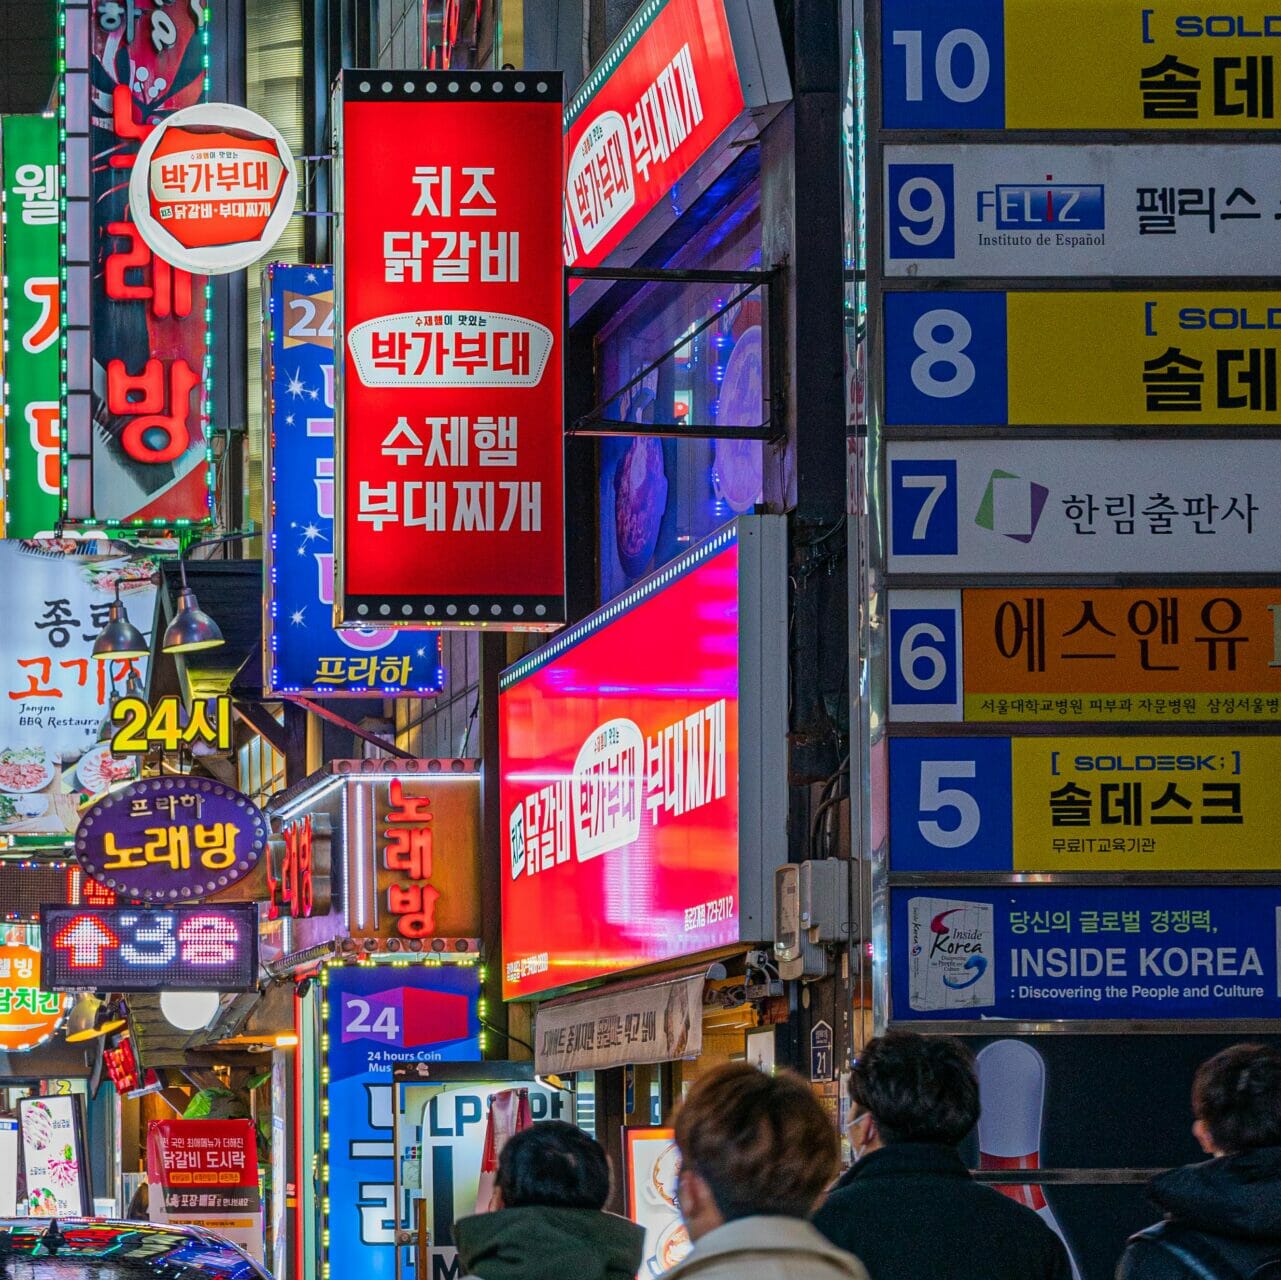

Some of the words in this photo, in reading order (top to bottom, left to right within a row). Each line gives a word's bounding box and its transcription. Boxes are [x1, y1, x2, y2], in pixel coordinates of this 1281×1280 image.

[892, 28, 990, 103] 10
[627, 42, 704, 183] 부대찌개
[161, 161, 268, 194] 박가부대
[411, 166, 497, 218] 치즈
[574, 130, 629, 229] 박가부대
[897, 177, 946, 247] 9
[383, 231, 520, 283] 닭갈비
[978, 233, 1032, 248] Instituto
[1036, 233, 1051, 247] de
[1055, 233, 1106, 250] Español
[458, 315, 487, 327] 맛있는
[372, 333, 530, 377] 박가부대
[910, 309, 976, 398] 8
[381, 417, 518, 467] 수제햄
[358, 481, 542, 532] 부대찌개
[901, 475, 948, 540] 7
[1061, 493, 1259, 536] 한림출판사
[994, 596, 1249, 673] 에스앤유
[316, 657, 413, 687] 프라하
[898, 623, 948, 691] 6
[19, 717, 42, 727] BBQ
[112, 697, 231, 751] 24시
[981, 698, 1083, 715] 서울대학교병원
[1089, 698, 1132, 714] 피부과
[1138, 698, 1197, 715] 자문병원
[646, 699, 726, 826] 부대찌개
[130, 794, 205, 820] 프라하
[525, 772, 571, 877] 닭갈비
[917, 759, 981, 848] 5
[1050, 782, 1244, 827] 솔데스크
[104, 823, 240, 870] 노래방
[386, 779, 441, 938] 노래방
[1052, 838, 1156, 855] 무료IT교육기관
[953, 928, 983, 941] Inside
[1010, 910, 1070, 934] 당신의
[1079, 910, 1141, 934] 글로벌
[930, 933, 983, 959] Korea
[1011, 948, 1128, 977] INSIDE
[1140, 948, 1264, 977] KOREA
[1019, 985, 1102, 1001] Discovering
[1105, 985, 1123, 998] the
[1131, 985, 1175, 1001] People
[1178, 985, 1199, 997] and
[1213, 985, 1264, 997] Culture
[346, 999, 400, 1040] 24
[625, 1013, 640, 1044] 먹고
[367, 1051, 380, 1061] 24
[383, 1051, 414, 1061] hours
[417, 1051, 441, 1061] Coin
[817, 1052, 826, 1074] 21
[162, 1151, 201, 1169] 닭갈비
[207, 1151, 246, 1169] 도시락
